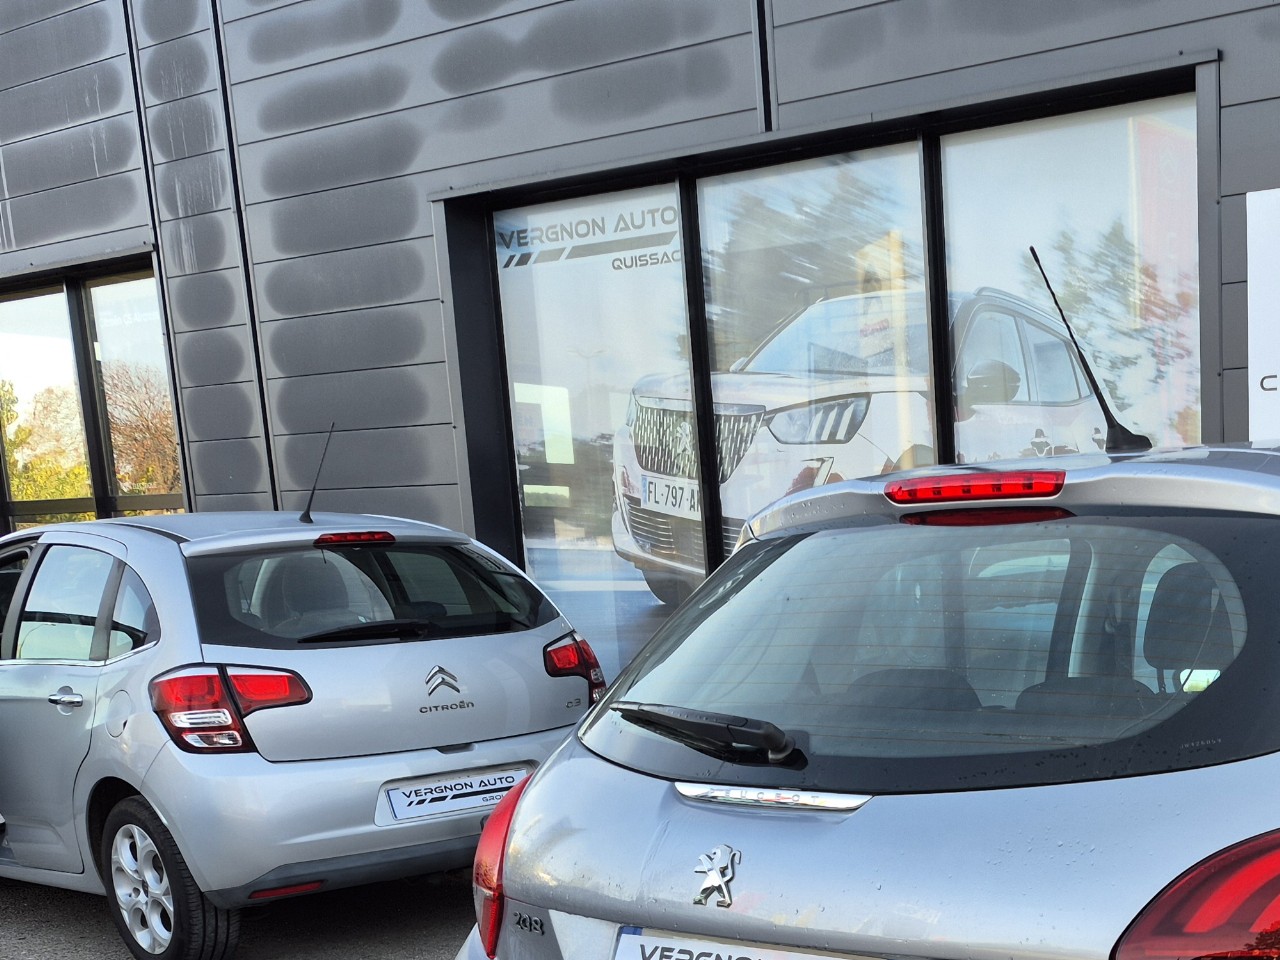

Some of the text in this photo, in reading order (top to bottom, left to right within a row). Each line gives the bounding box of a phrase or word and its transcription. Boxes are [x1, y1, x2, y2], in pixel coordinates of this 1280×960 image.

[500, 206, 678, 249] VERGNON AUTO
[611, 250, 682, 271] QUISSAC
[565, 698, 582, 709] C3
[402, 775, 516, 798] VERGNON AUTO
[709, 787, 820, 804] PEUGEOT
[481, 794, 504, 802] GRO
